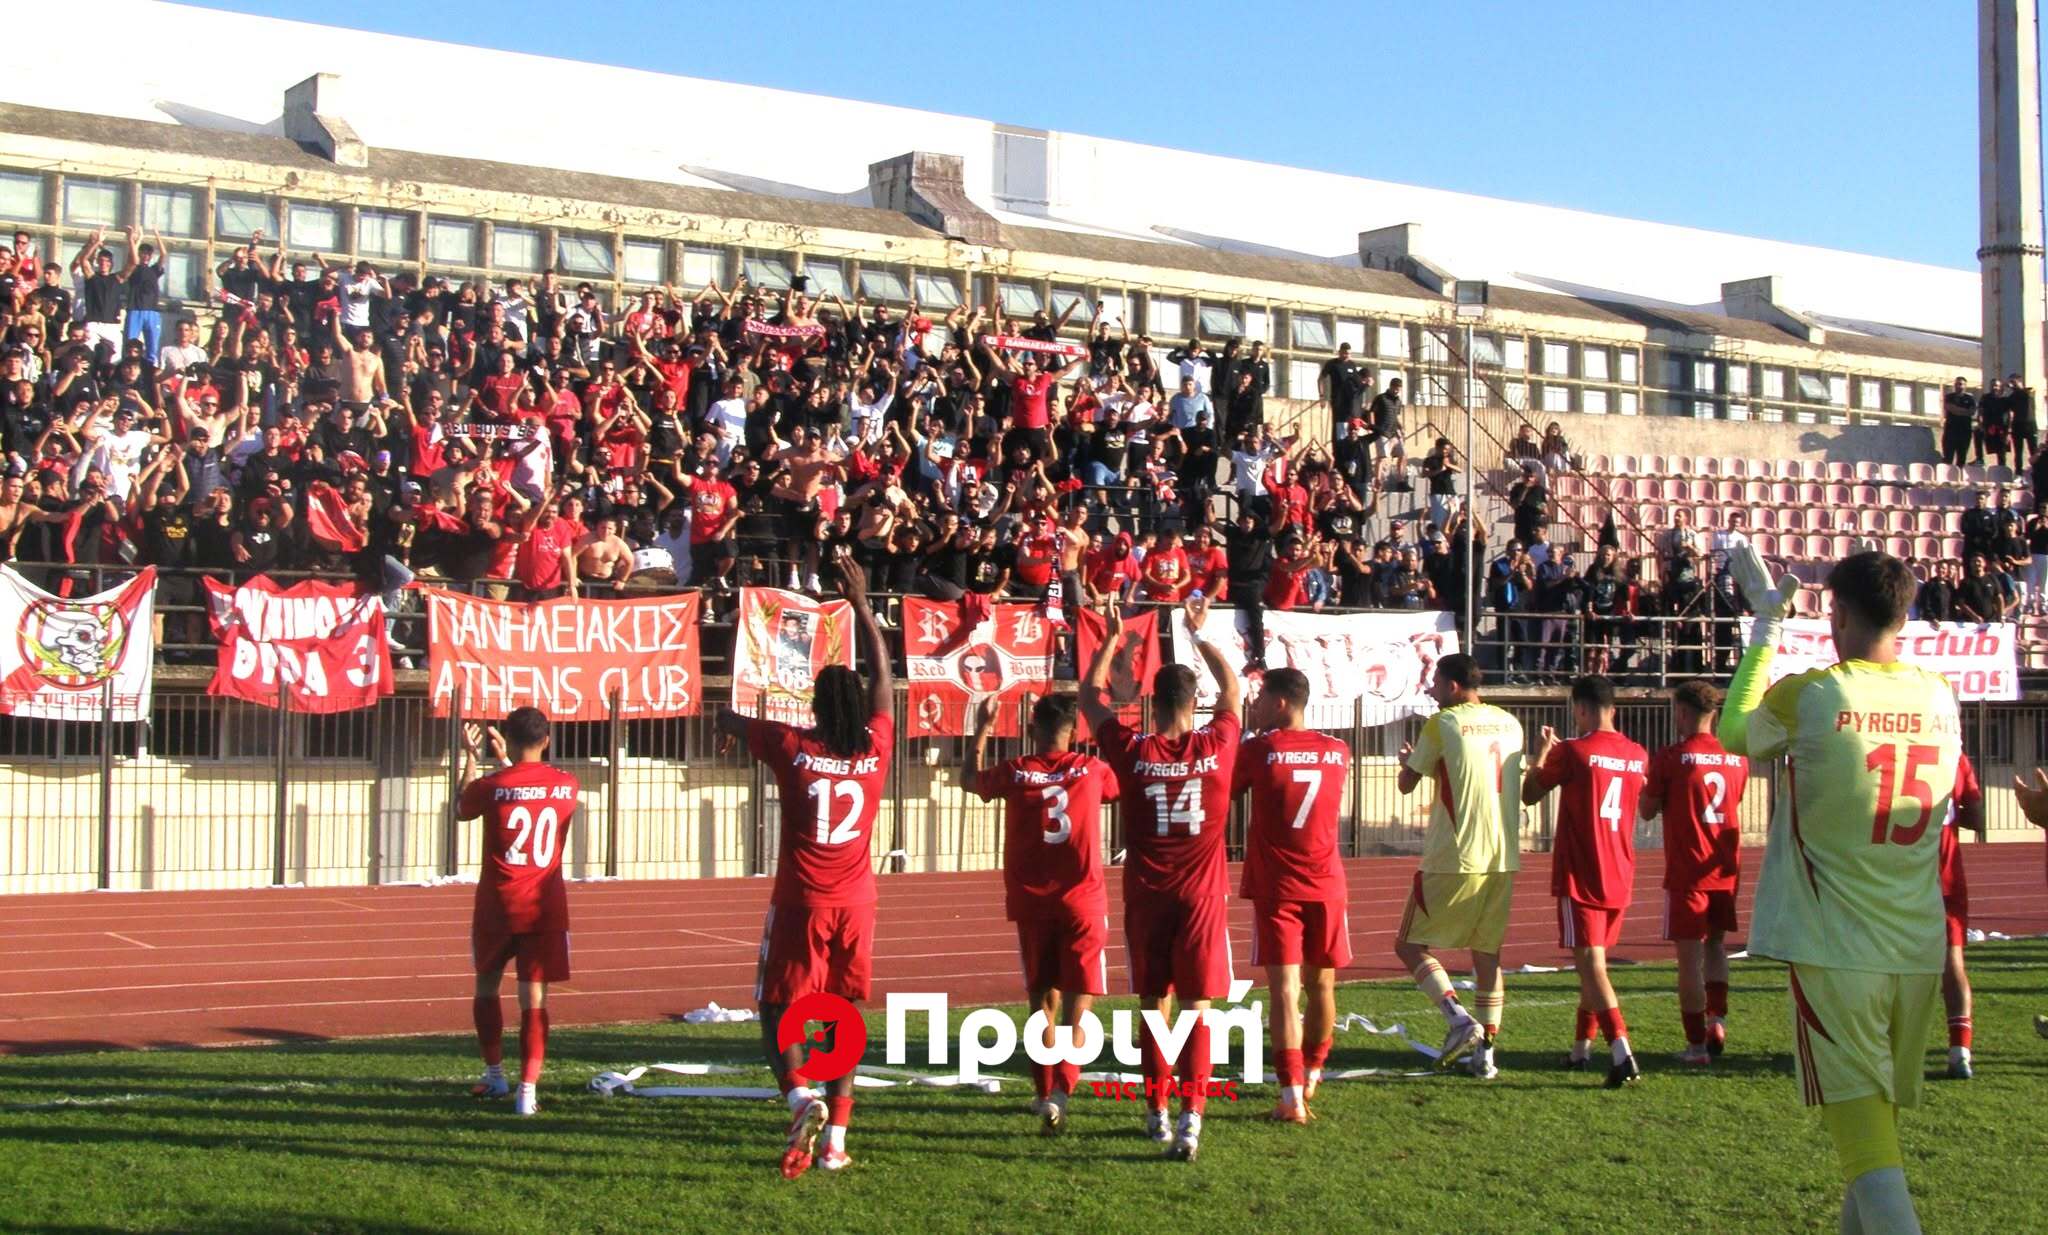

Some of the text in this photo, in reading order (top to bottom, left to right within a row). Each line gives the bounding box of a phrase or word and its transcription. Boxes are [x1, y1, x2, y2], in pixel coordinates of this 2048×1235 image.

[430, 594, 688, 653] ΠΑΝΗΛΕΙΑΚΟΣ
[434, 663, 689, 715] ATHENS CLUB
[912, 661, 1050, 680] Red Boys
[1836, 711, 1921, 733] PYRGOS
[793, 753, 880, 777] PYRGOS AFC
[1015, 769, 1065, 785] PYRGOS
[1133, 755, 1219, 777] PYRGOS AFC
[1267, 751, 1343, 766] PYRGOS AFC
[1488, 740, 1503, 794] 1
[1589, 754, 1644, 774] PYRGOS AFC
[1681, 752, 1742, 768] PYRGOS AFC
[494, 785, 572, 802] PYRGOS AFC
[808, 778, 865, 845] 12
[1041, 785, 1073, 845] 3
[1144, 778, 1206, 837] 14
[1292, 769, 1322, 829] 7
[1600, 776, 1624, 832] 4
[1702, 772, 1727, 824] 2
[1866, 743, 1940, 846] 15
[506, 806, 558, 868] 20
